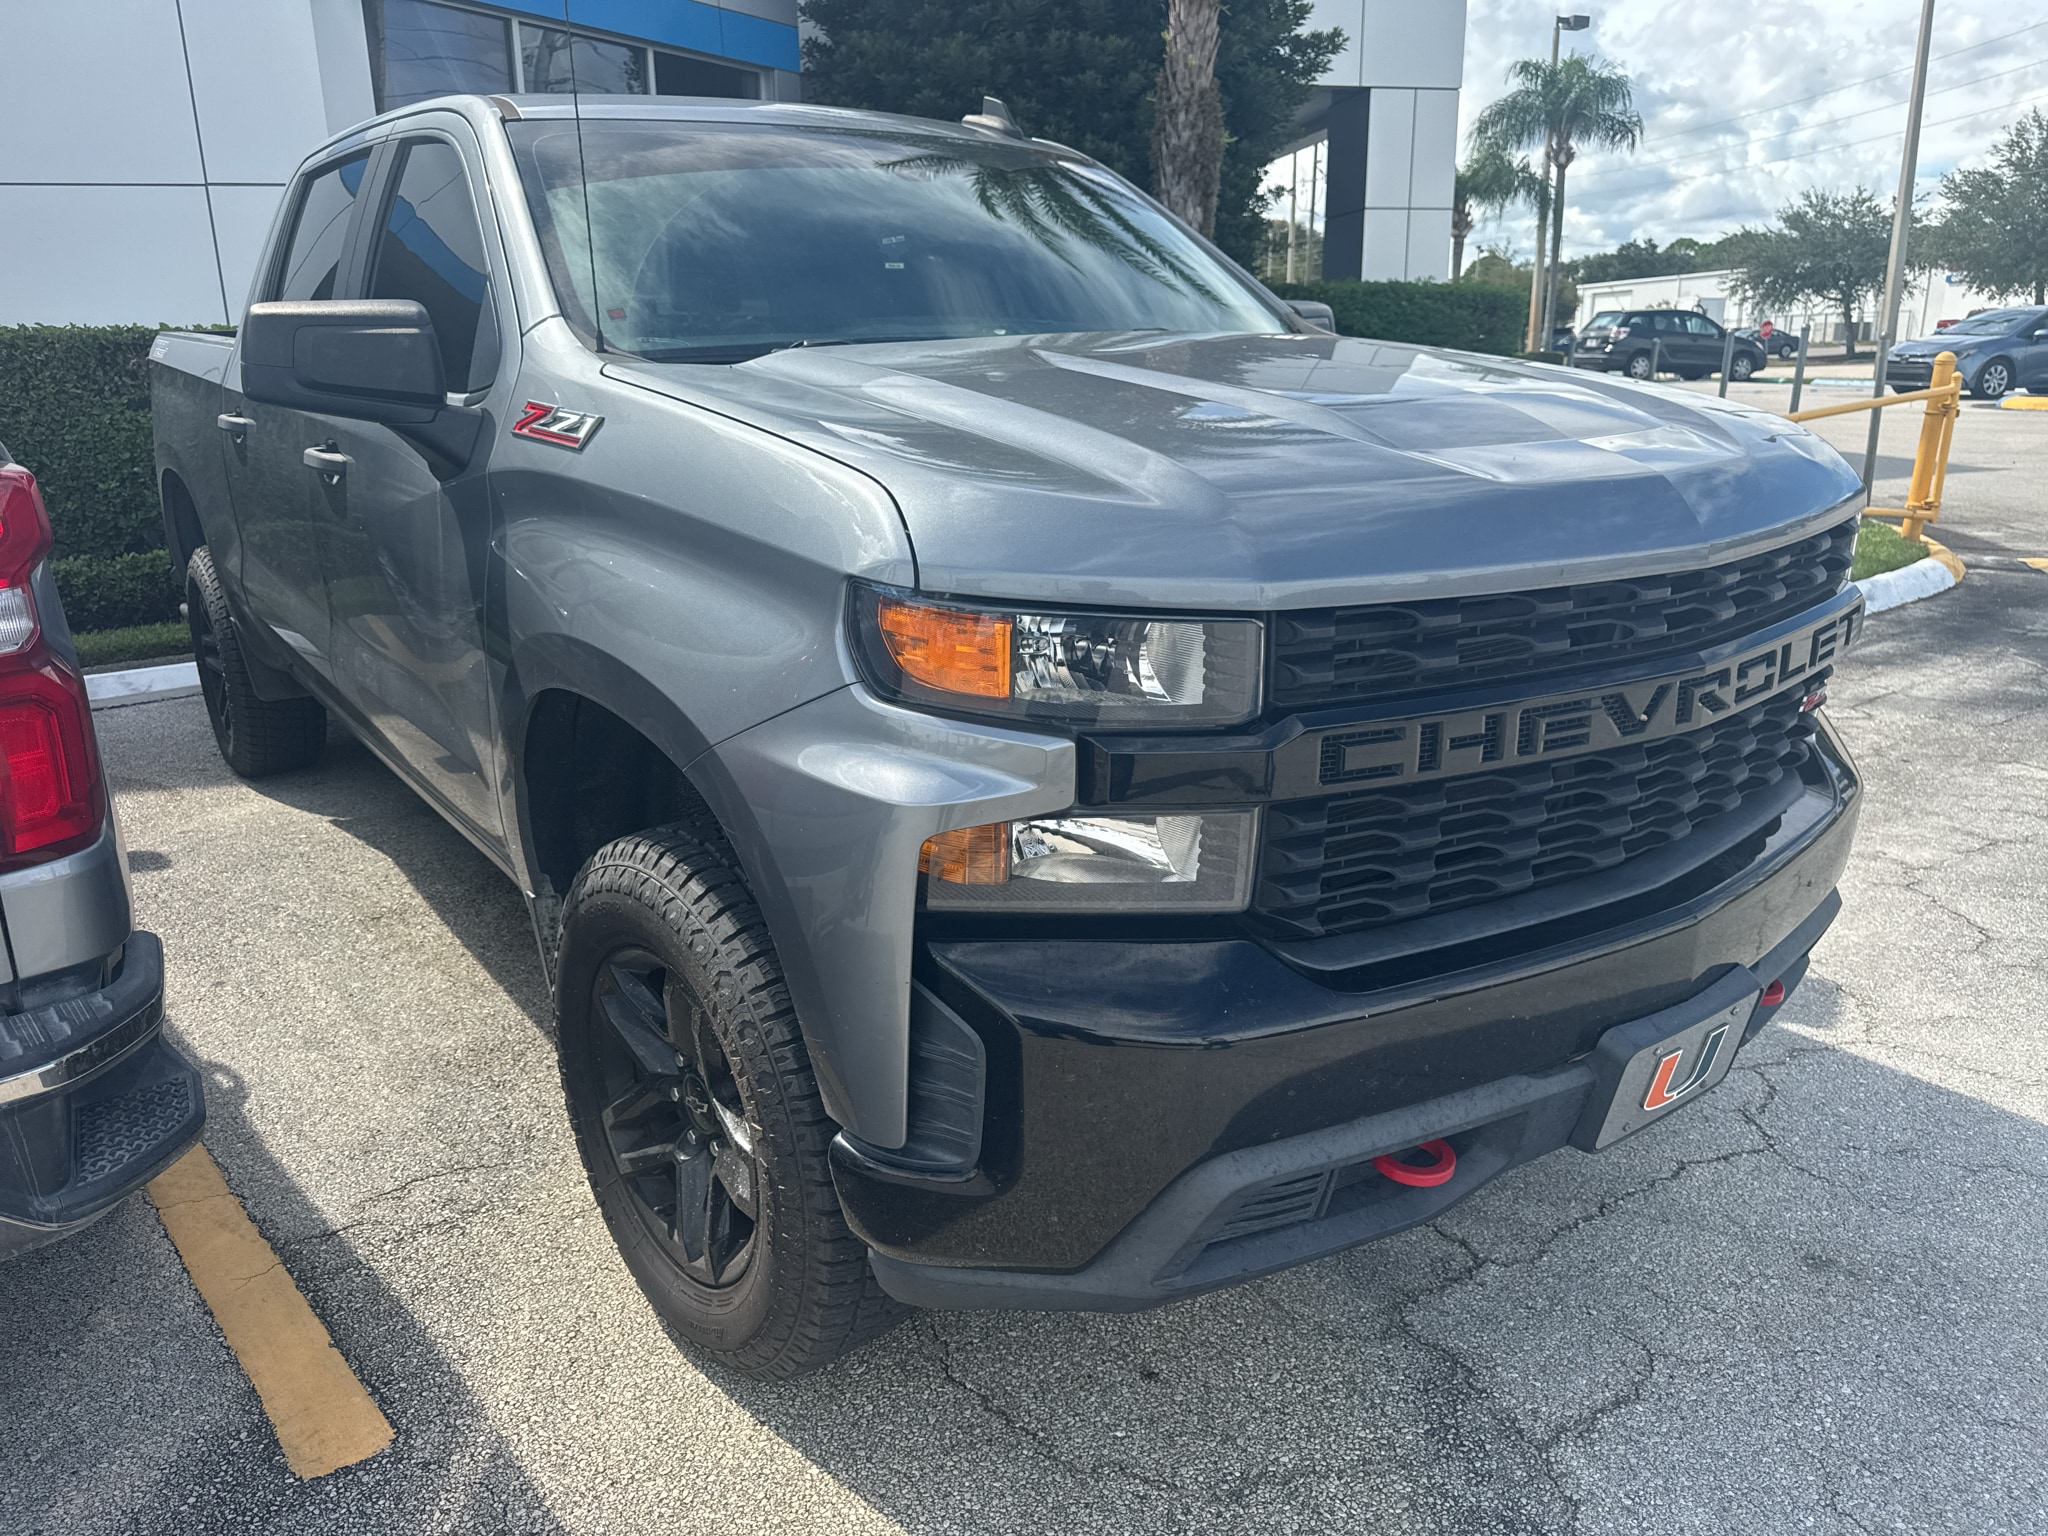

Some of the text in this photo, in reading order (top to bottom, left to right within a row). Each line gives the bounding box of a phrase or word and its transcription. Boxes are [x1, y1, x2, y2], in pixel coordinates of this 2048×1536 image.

[511, 399, 605, 454] Z71
[1318, 603, 1862, 786] CHEVROLET
[1642, 1023, 1729, 1111] U
